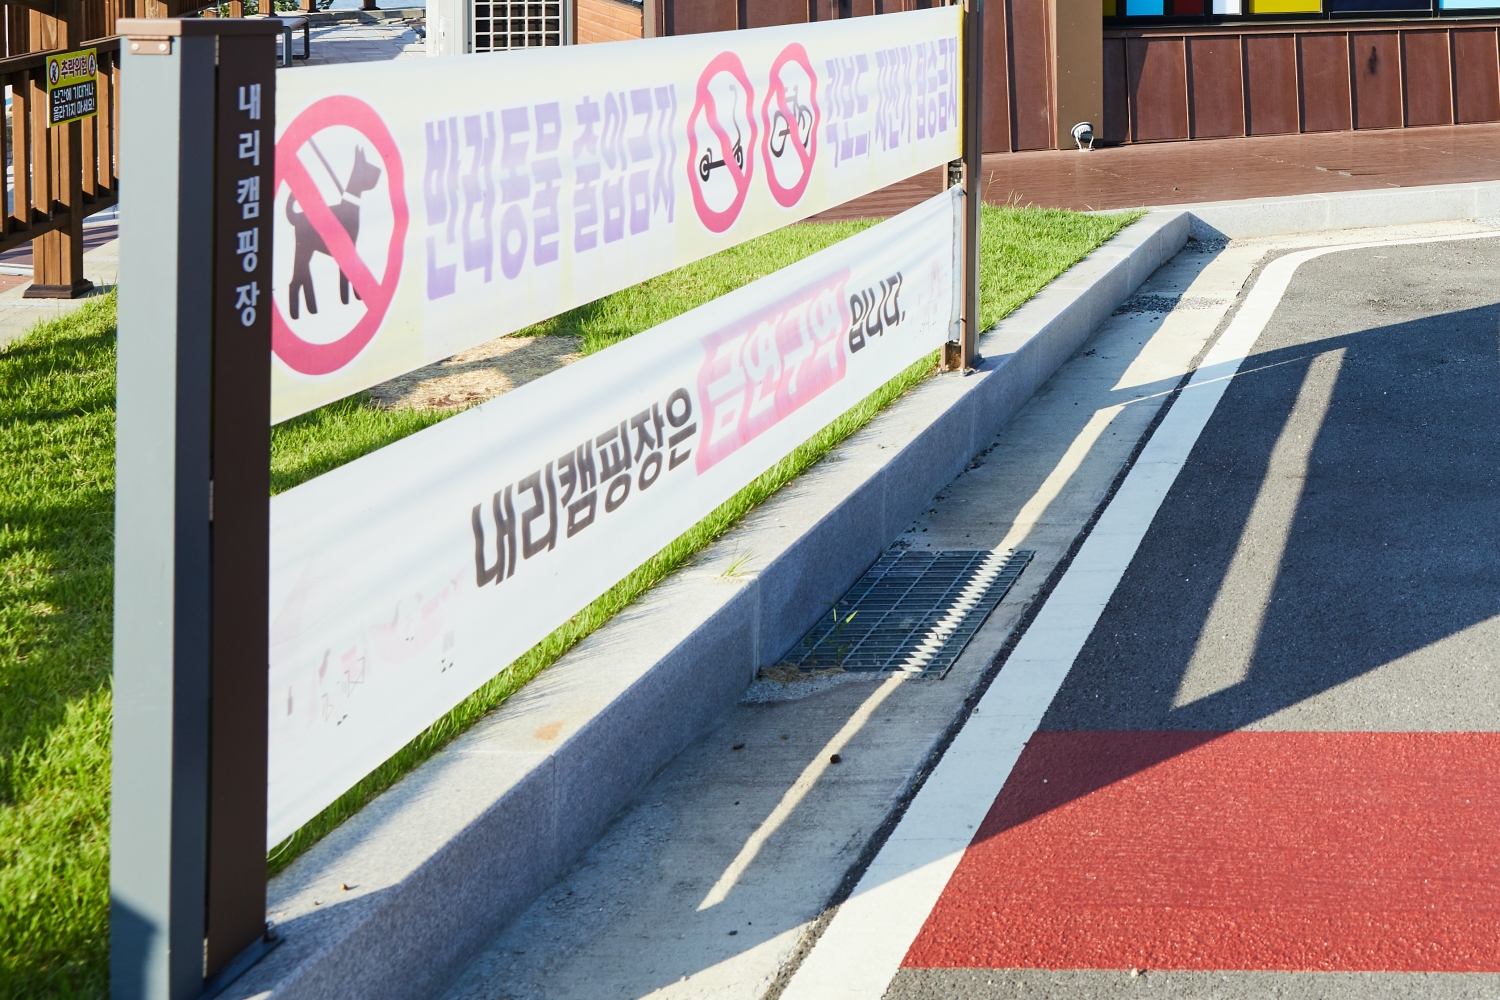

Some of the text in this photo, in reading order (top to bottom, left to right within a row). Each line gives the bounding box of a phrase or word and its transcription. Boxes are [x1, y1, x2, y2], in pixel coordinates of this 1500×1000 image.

[53, 83, 94, 104] 난간에 기대거나
[53, 98, 95, 121] 올라가지 마세요!
[61, 56, 88, 79] 추락위험
[875, 45, 912, 153] 자전거
[915, 36, 957, 140] 탑승금지
[235, 83, 262, 327] 내리캠핑장
[423, 84, 677, 300] 반려동물 출입금지
[471, 271, 906, 588] 내리캠핑장은 금연구역 입니다.
